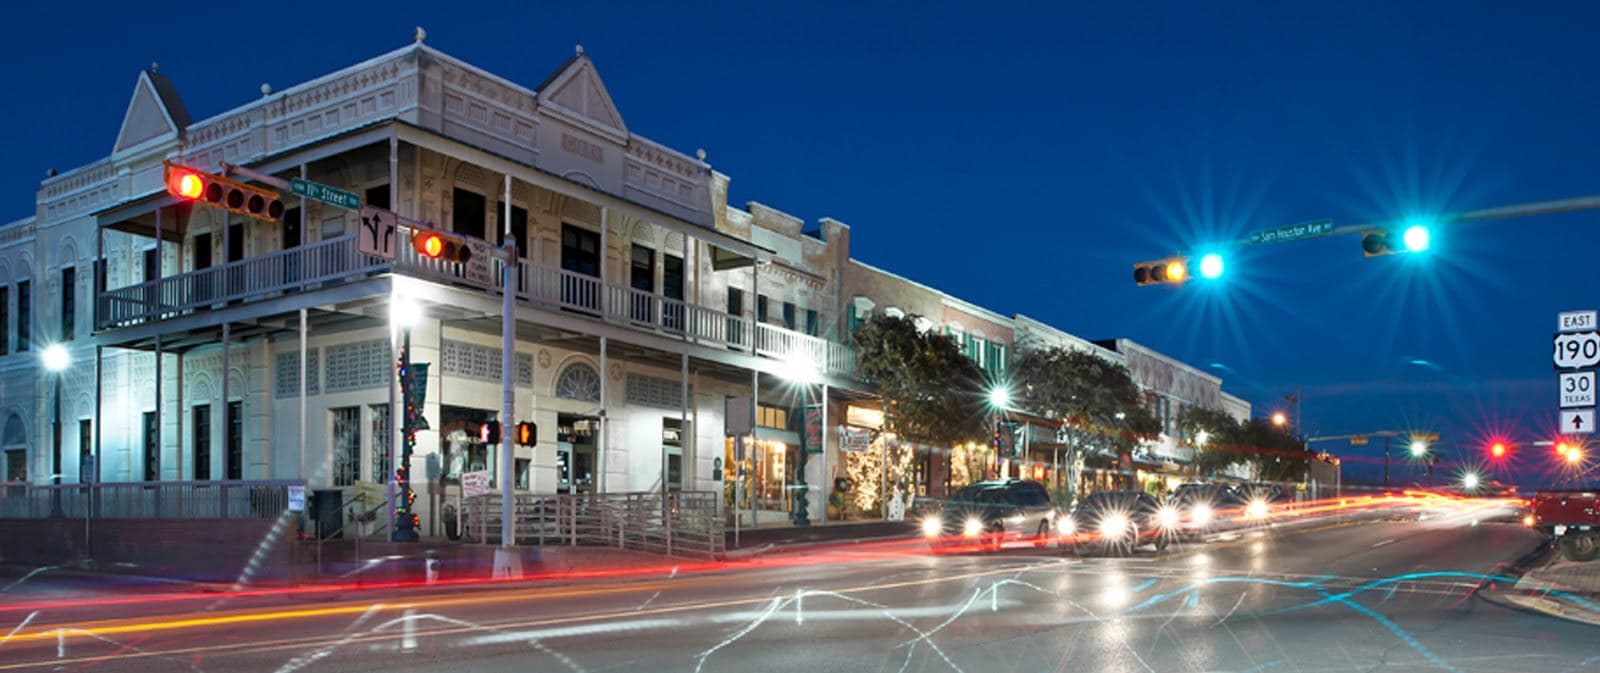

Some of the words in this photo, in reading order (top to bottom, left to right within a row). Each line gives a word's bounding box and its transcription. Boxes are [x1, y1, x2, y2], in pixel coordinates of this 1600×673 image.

[321, 188, 347, 205] Street
[1261, 231, 1275, 242] Sam
[1307, 224, 1321, 233] Ave
[473, 243, 485, 253] NO
[1563, 315, 1591, 328] EAST
[1558, 339, 1598, 361] 190
[1565, 376, 1590, 393] 30
[1564, 395, 1591, 404] TEXAS
